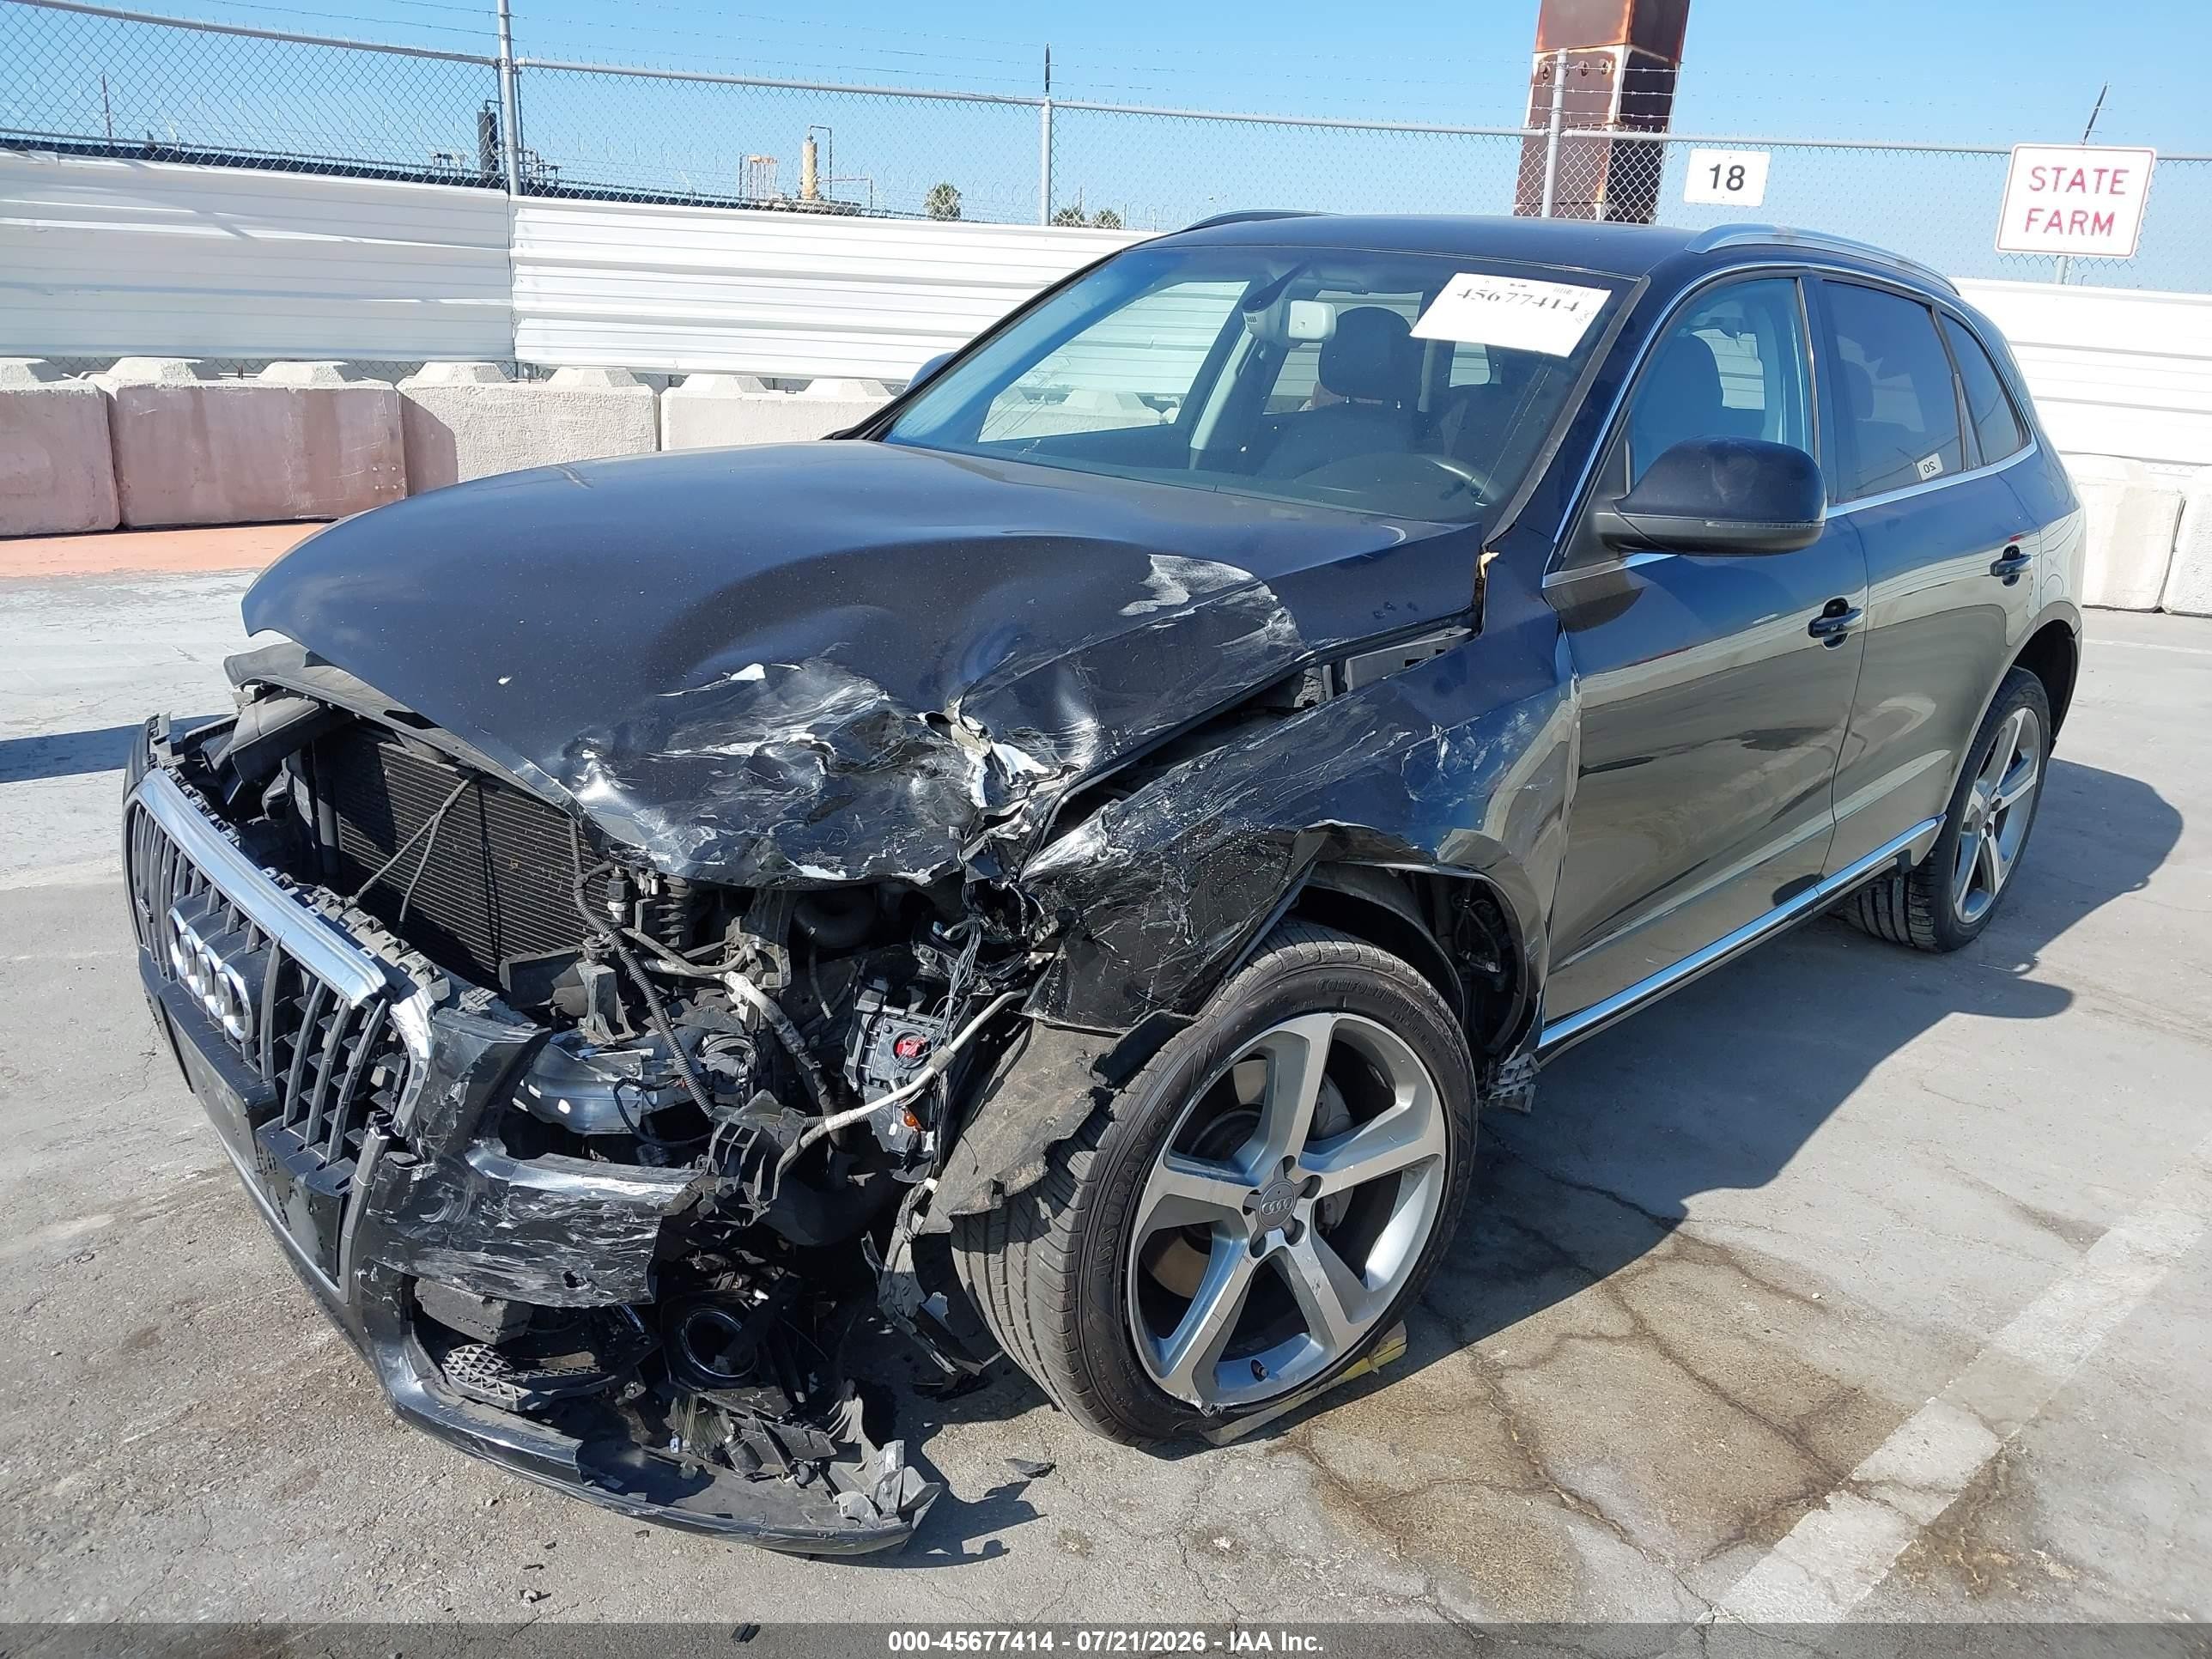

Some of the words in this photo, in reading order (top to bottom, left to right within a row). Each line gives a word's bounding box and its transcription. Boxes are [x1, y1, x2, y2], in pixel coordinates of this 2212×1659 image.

[1709, 164, 1746, 191] 18
[2029, 166, 2130, 196] STATE
[2025, 208, 2116, 237] FARM
[1456, 288, 1580, 313] 45677414
[1091, 1097, 1174, 1283] ASSURANCE
